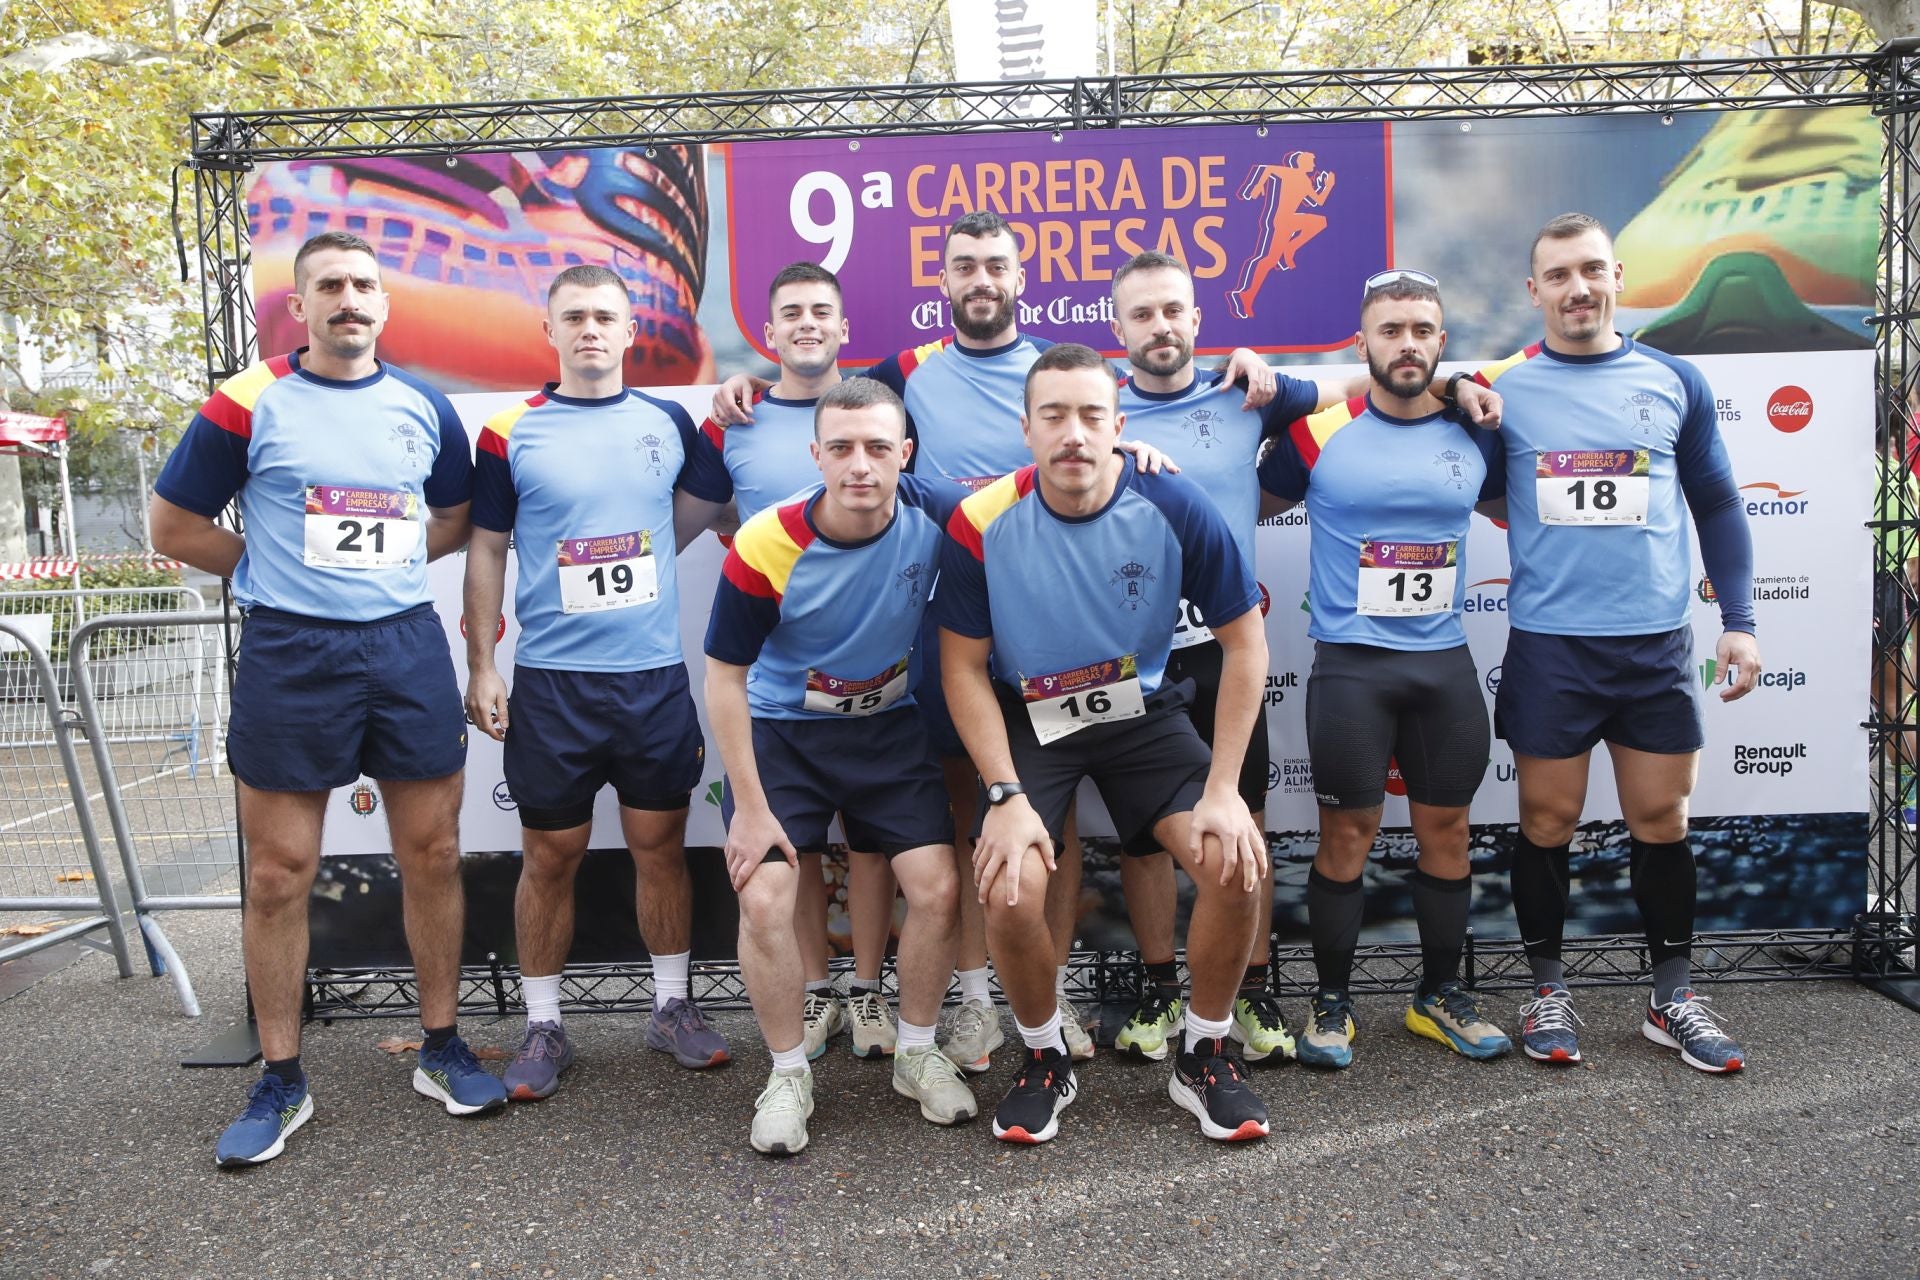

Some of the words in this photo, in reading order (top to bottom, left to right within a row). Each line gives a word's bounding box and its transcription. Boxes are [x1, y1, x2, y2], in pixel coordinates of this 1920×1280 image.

[907, 158, 1146, 217] CARRERA
[1162, 156, 1227, 209] DE
[910, 216, 1227, 288] EPRESAS
[911, 301, 944, 329] El
[1018, 299, 1043, 325] de
[1717, 399, 1732, 410] DE
[1769, 401, 1811, 417] Coca-Cola
[1573, 452, 1603, 460] CARRERA
[1605, 452, 1614, 460] DE
[1573, 459, 1614, 468] EMPRESAS
[346, 491, 378, 501] CARRERA
[380, 493, 388, 501] DE
[1567, 480, 1617, 510] 18
[346, 498, 388, 509] EMPRESAS
[1742, 498, 1808, 516] ecnor
[336, 520, 384, 553] 21
[589, 538, 618, 548] CARRERA
[619, 536, 626, 544] DE
[590, 543, 627, 555] EMPRESAS
[1395, 545, 1425, 553] CARRERA
[1427, 545, 1435, 553] DE
[1395, 552, 1434, 561] EMPRESAS
[587, 564, 633, 596] 19
[1388, 572, 1433, 602] 13
[1799, 575, 1809, 583] de
[1058, 668, 1089, 681] CARRERA
[1091, 665, 1099, 674] DE
[1060, 672, 1101, 688] EMPRESAS
[835, 690, 882, 712] 15
[1060, 690, 1112, 718] 16
[1734, 743, 1807, 760] Renault
[1734, 759, 1792, 777] Group
